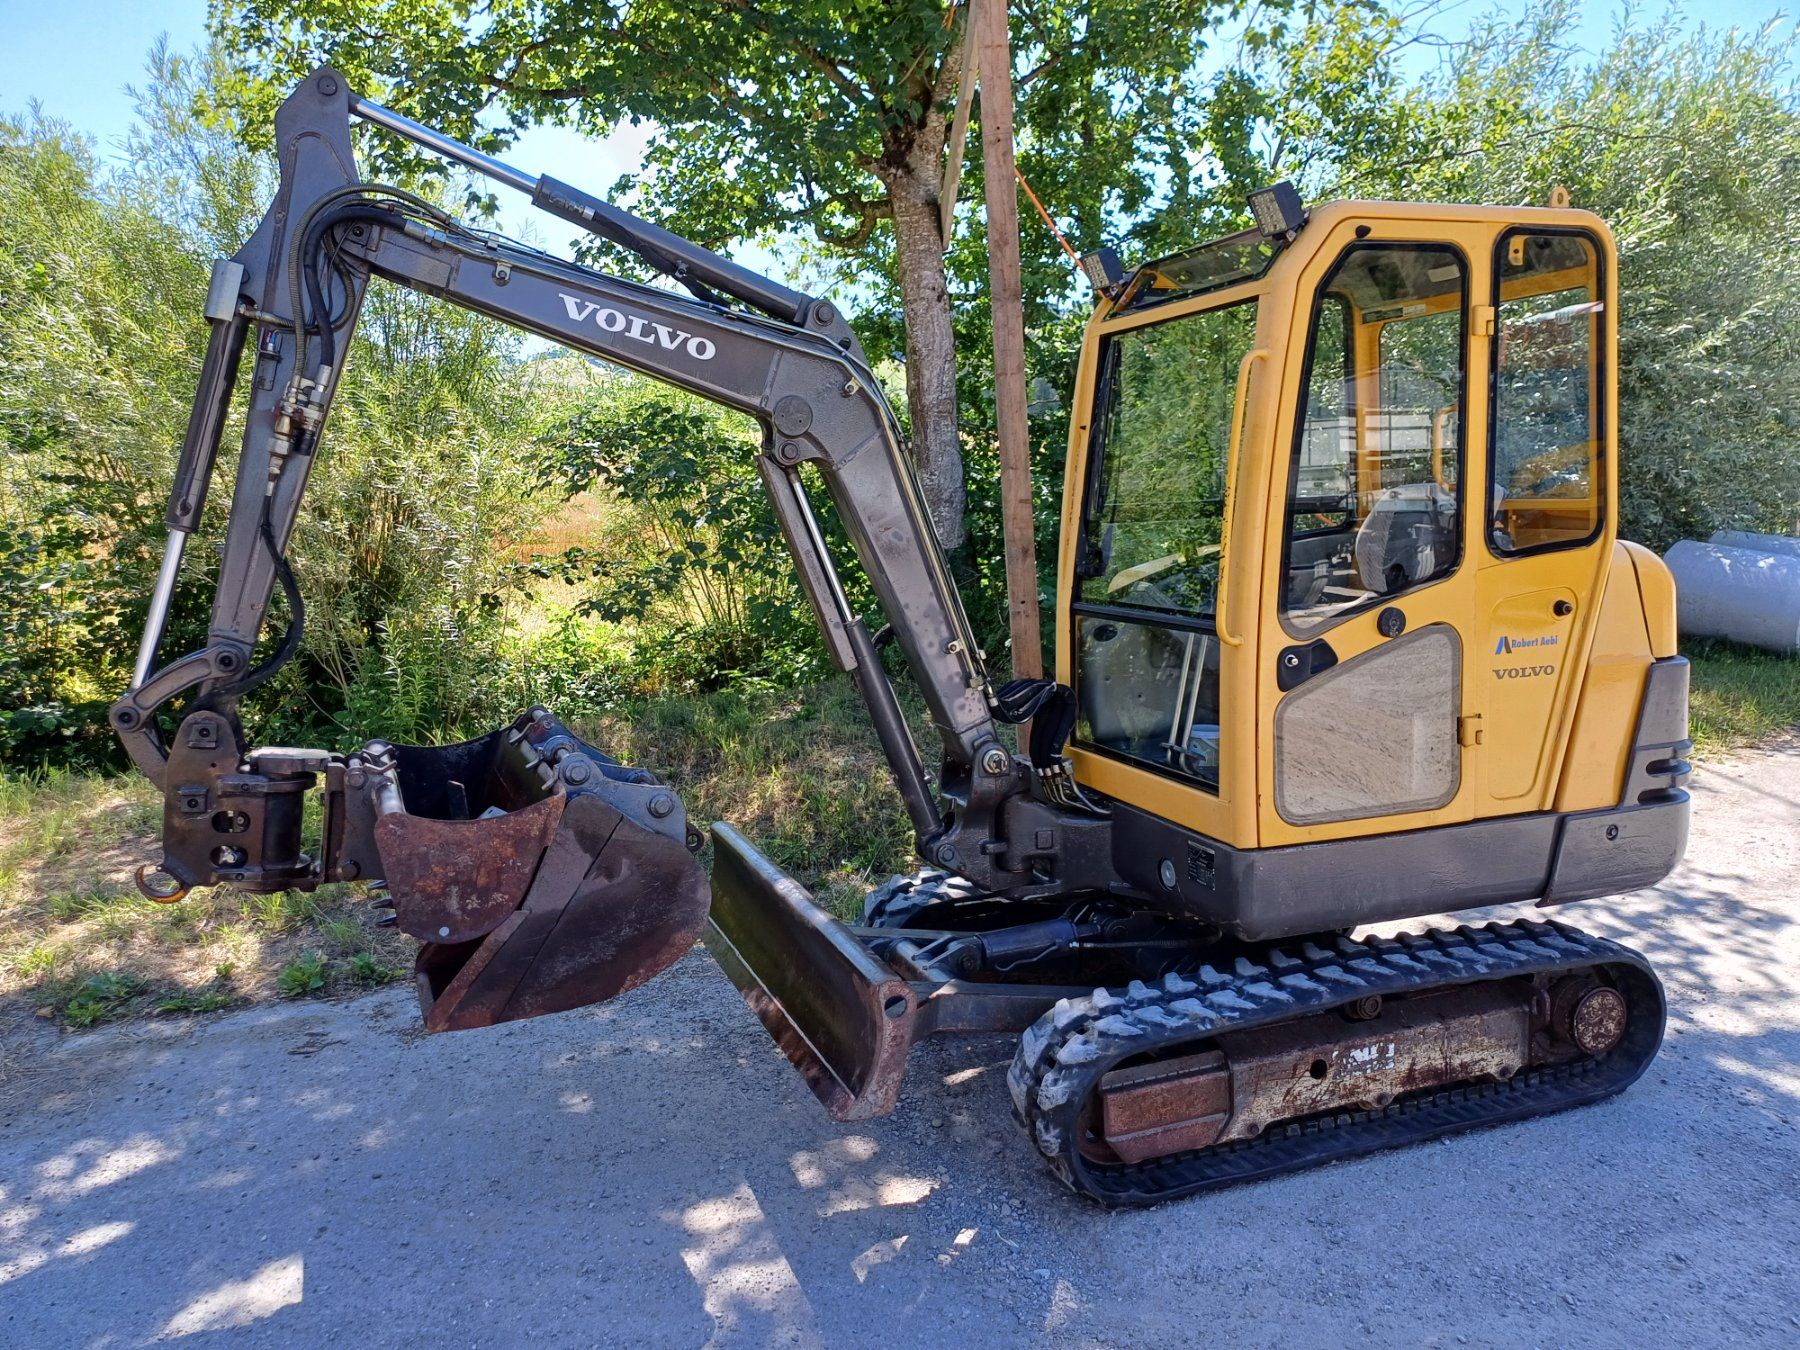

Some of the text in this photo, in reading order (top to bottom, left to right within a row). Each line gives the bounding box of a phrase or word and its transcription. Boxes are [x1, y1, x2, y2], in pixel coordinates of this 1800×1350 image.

[558, 293, 716, 360] VOLVO
[1511, 635, 1558, 648] Robert Aebi
[1492, 664, 1555, 680] VOLVO
